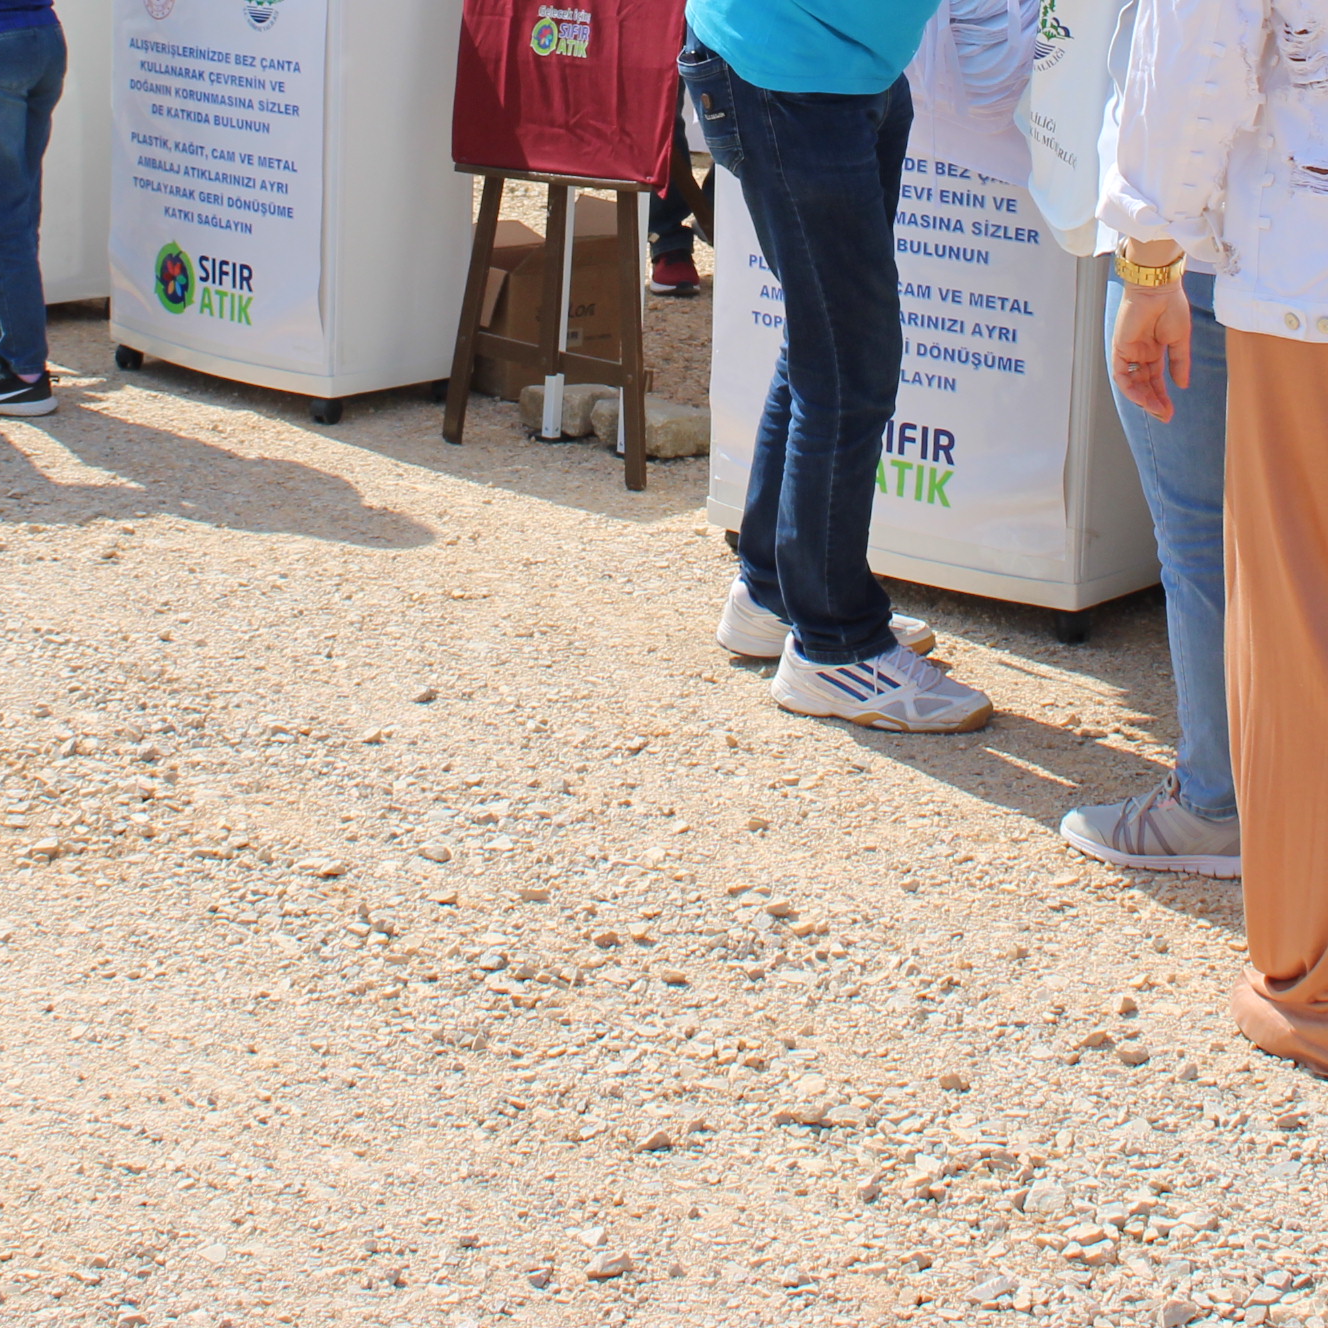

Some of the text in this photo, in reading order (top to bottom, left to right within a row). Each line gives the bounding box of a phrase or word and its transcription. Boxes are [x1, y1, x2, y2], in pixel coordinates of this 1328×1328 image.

[556, 39, 588, 58] ATIK
[559, 23, 590, 41] SIFIR
[129, 38, 301, 73] ALIŞVERİŞLERİNİZDE BEZ ÇANTA
[140, 60, 285, 93] KULLANARAK ÇEVRENİN VE
[130, 78, 300, 117] DOĞANIN KORUNMASINA SİZLER
[152, 103, 270, 134] DE KATKIDA BULUNUN
[131, 132, 298, 173] PLASTİK, KAĞIT, CAM VE METAL
[138, 155, 288, 194] AMBALAJ ATIKLARINIZI AYRI
[133, 176, 294, 218] TOPLAYARAK GERİ DÖNÜŞÜME
[992, 196, 1017, 213] VE
[164, 206, 253, 234] KATKI SAĞLAYIN
[972, 219, 1040, 245] SİZLER
[897, 238, 989, 265] BULUNUN
[198, 255, 254, 292] SIFIR
[199, 287, 252, 326] ATIK
[938, 287, 963, 304] VE
[969, 292, 1034, 315] METAL
[971, 322, 1018, 343] AYRI
[916, 341, 1025, 374] DÖNÜŞÜME
[885, 419, 955, 466] IFIR
